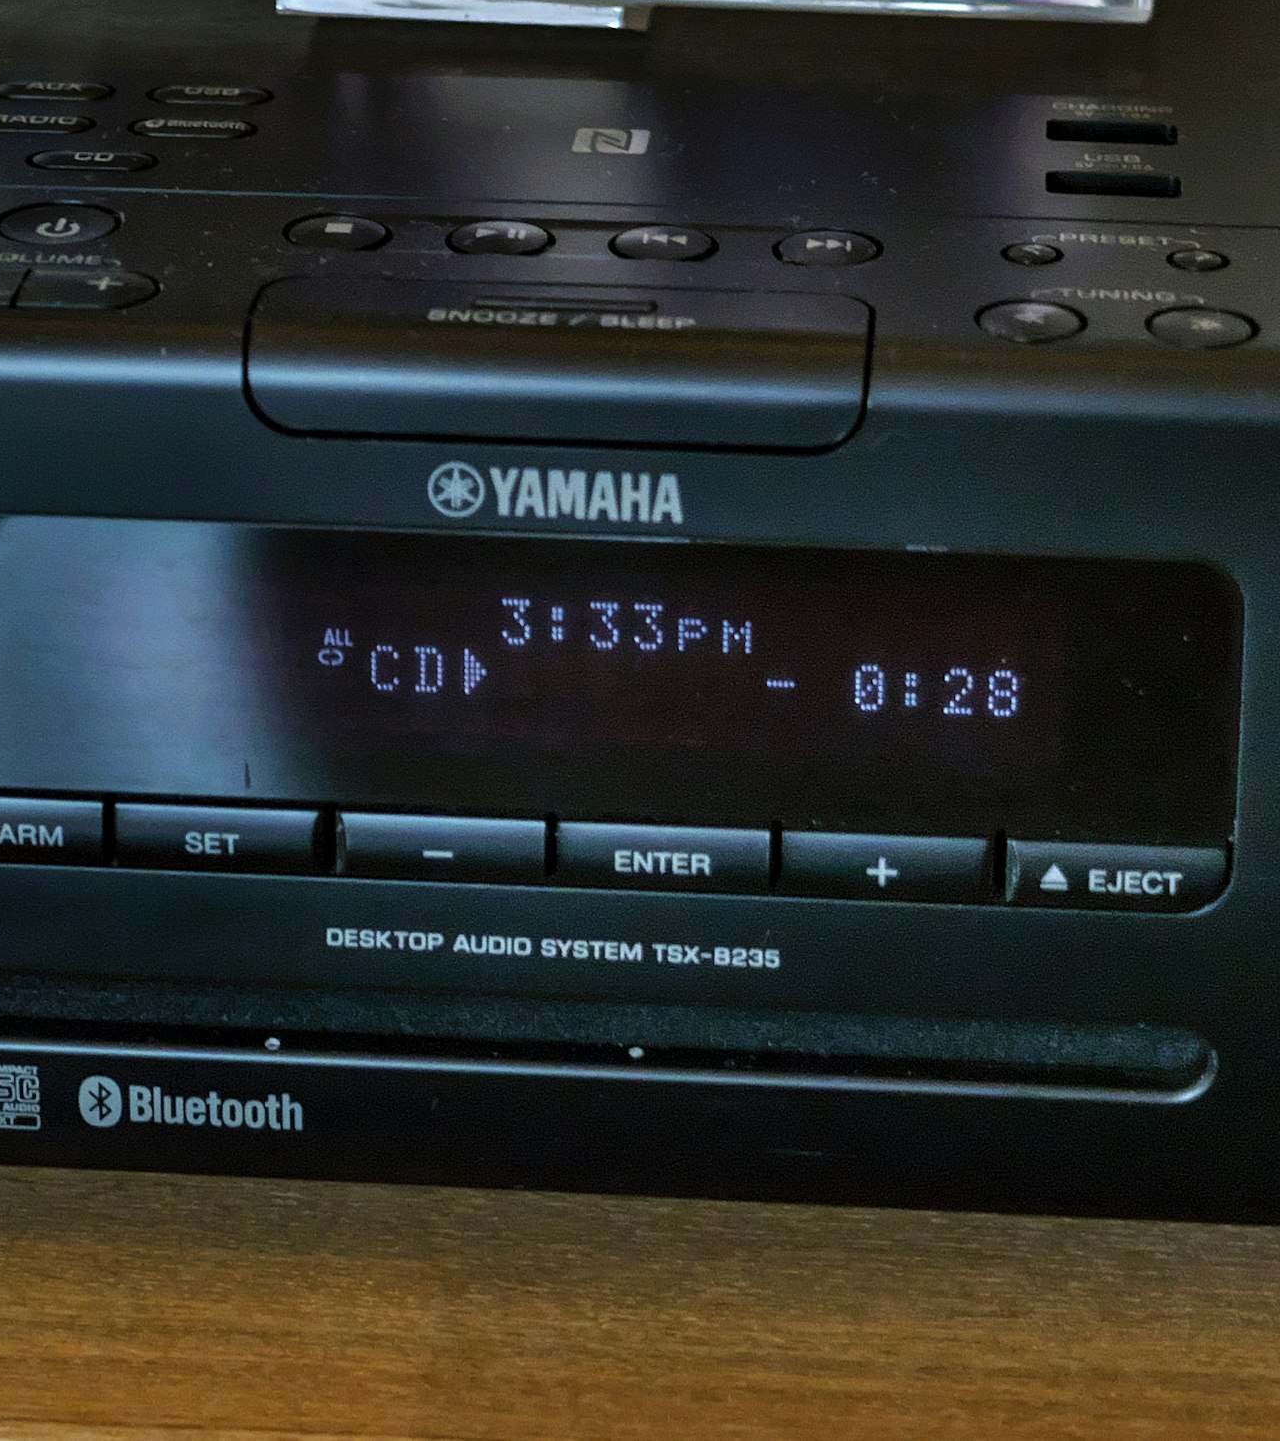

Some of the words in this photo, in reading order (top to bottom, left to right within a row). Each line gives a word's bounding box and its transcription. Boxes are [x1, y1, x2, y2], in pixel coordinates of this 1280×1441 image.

[73, 151, 115, 163] CD
[1060, 287, 1177, 305] TUNING
[490, 466, 684, 525] YAMAHA
[323, 627, 354, 647] ALL
[371, 644, 443, 694] CD
[854, 663, 1019, 717] 0:28
[184, 831, 240, 855] SET
[614, 849, 711, 877] ENTER
[1088, 868, 1184, 896] EJECT
[325, 927, 445, 951] DESKTOP
[452, 935, 532, 956] AUDIO
[540, 938, 643, 962] SYSTEM
[652, 944, 781, 968] TSX-B235
[3, 1102, 41, 1113] AUDIO
[129, 1085, 304, 1131] Bluetooth
